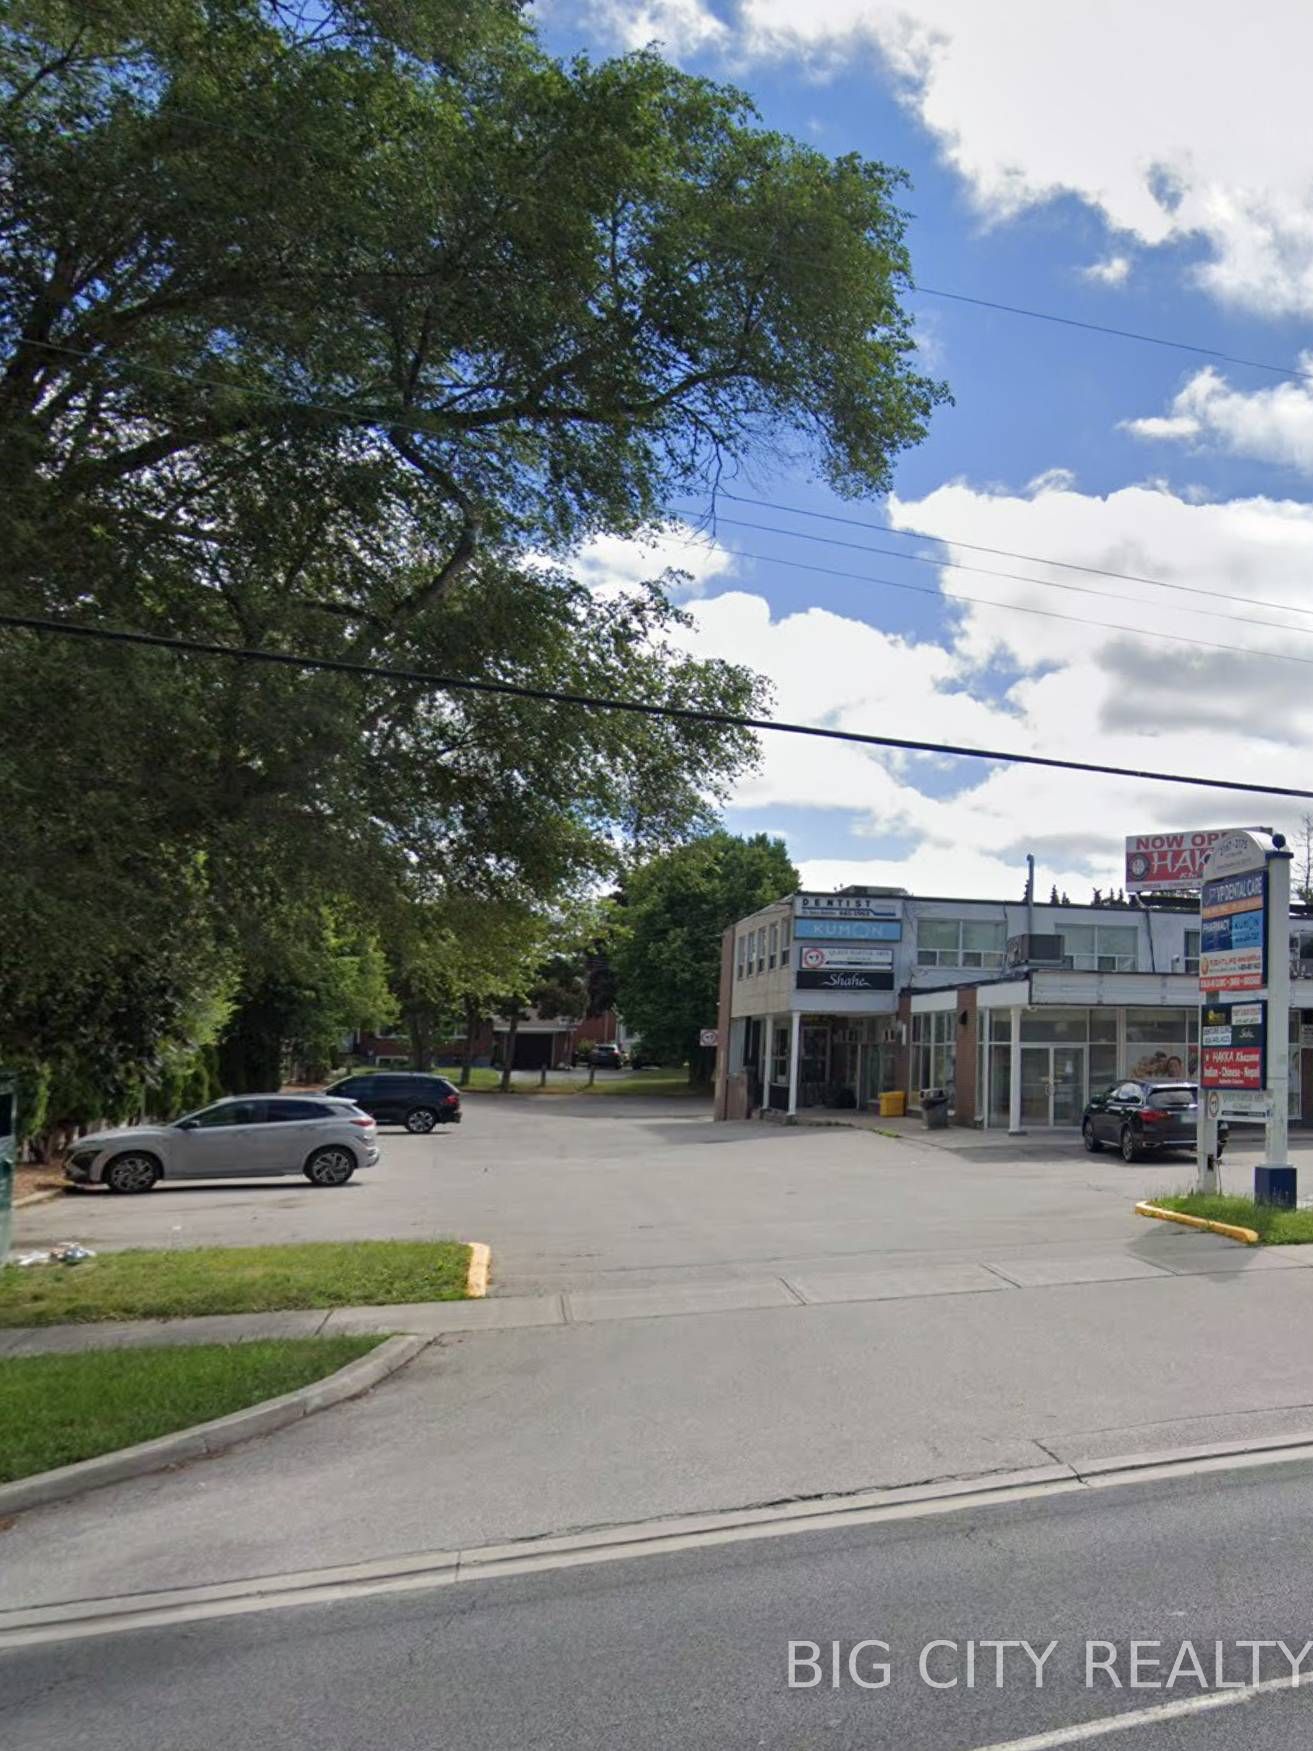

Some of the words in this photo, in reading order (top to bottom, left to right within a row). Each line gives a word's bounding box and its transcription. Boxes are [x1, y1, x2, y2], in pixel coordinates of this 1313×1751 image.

[1136, 834, 1184, 850] NOW
[1191, 832, 1228, 847] OP
[1152, 847, 1214, 875] HAK
[802, 898, 871, 908] DENTIST
[814, 923, 883, 938] KUMON
